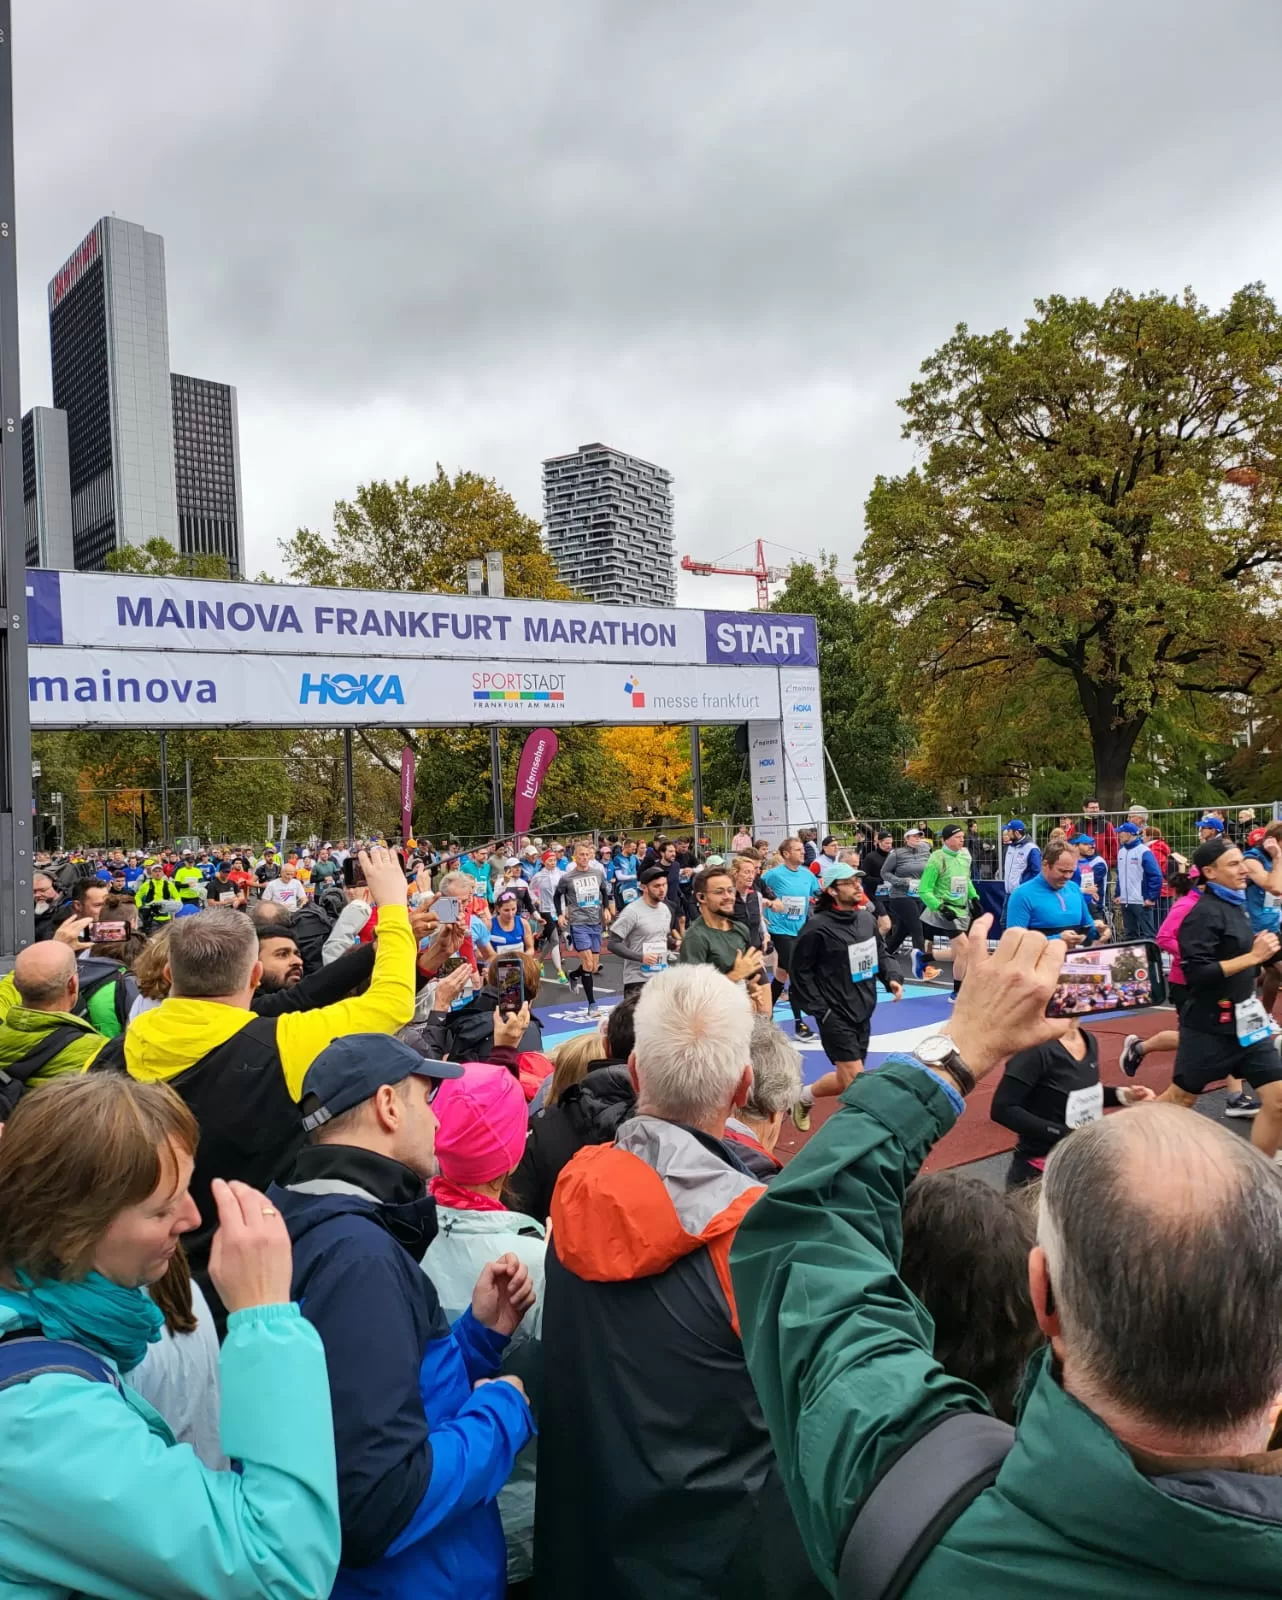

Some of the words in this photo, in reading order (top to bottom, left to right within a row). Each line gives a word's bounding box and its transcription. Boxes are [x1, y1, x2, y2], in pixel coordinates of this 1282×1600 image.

[117, 596, 303, 633] MAINOVA
[315, 606, 511, 641] FRANKFURT
[524, 617, 676, 647] MARATHON
[717, 623, 804, 654] START
[29, 669, 217, 703] mainova
[299, 673, 404, 705] HOKA
[472, 672, 566, 690] SPORTSTADT
[653, 695, 698, 708] messe
[702, 692, 760, 708] frankfurt
